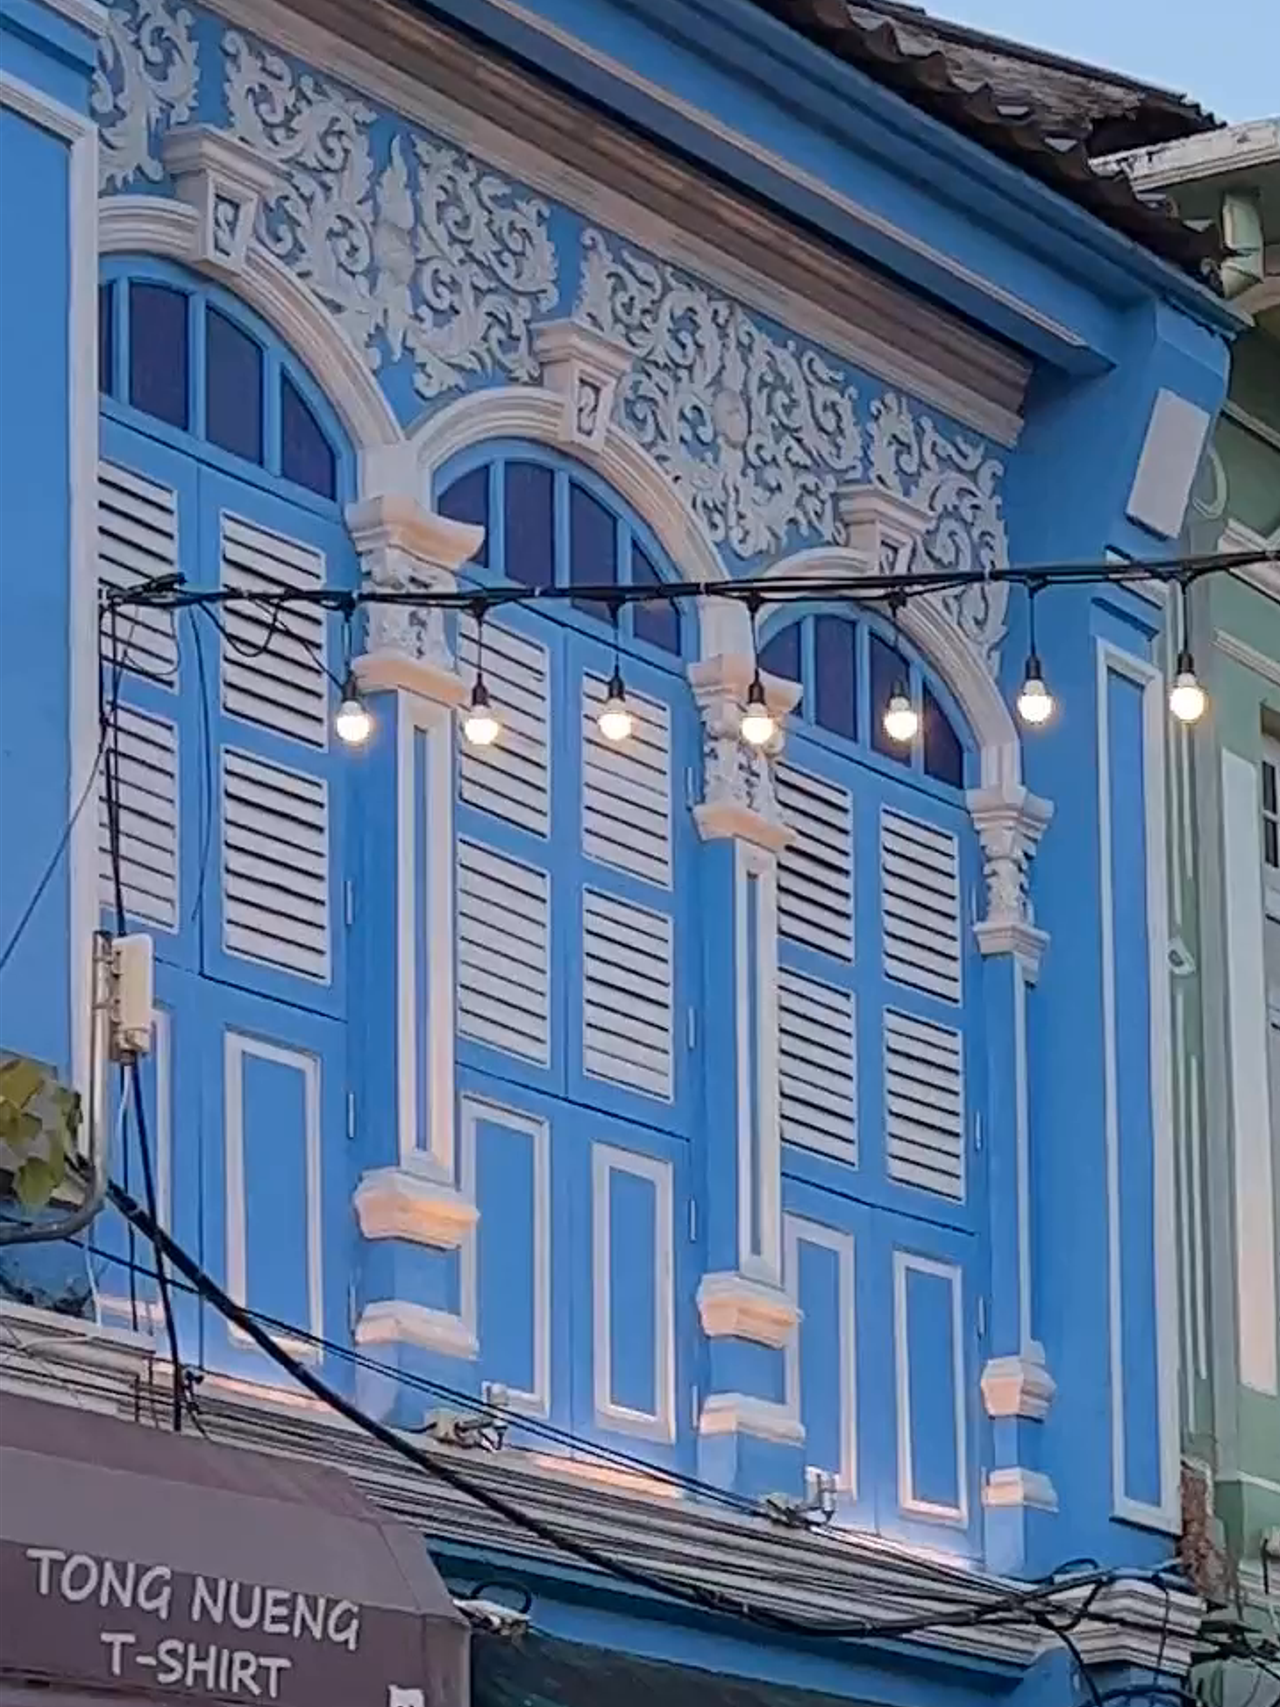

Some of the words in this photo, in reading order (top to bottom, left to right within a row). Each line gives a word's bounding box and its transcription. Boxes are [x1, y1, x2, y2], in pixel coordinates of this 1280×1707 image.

[25, 1547, 172, 1621] TONG
[190, 1574, 361, 1652] NUENG
[100, 1630, 292, 1699] T-SHIRT
